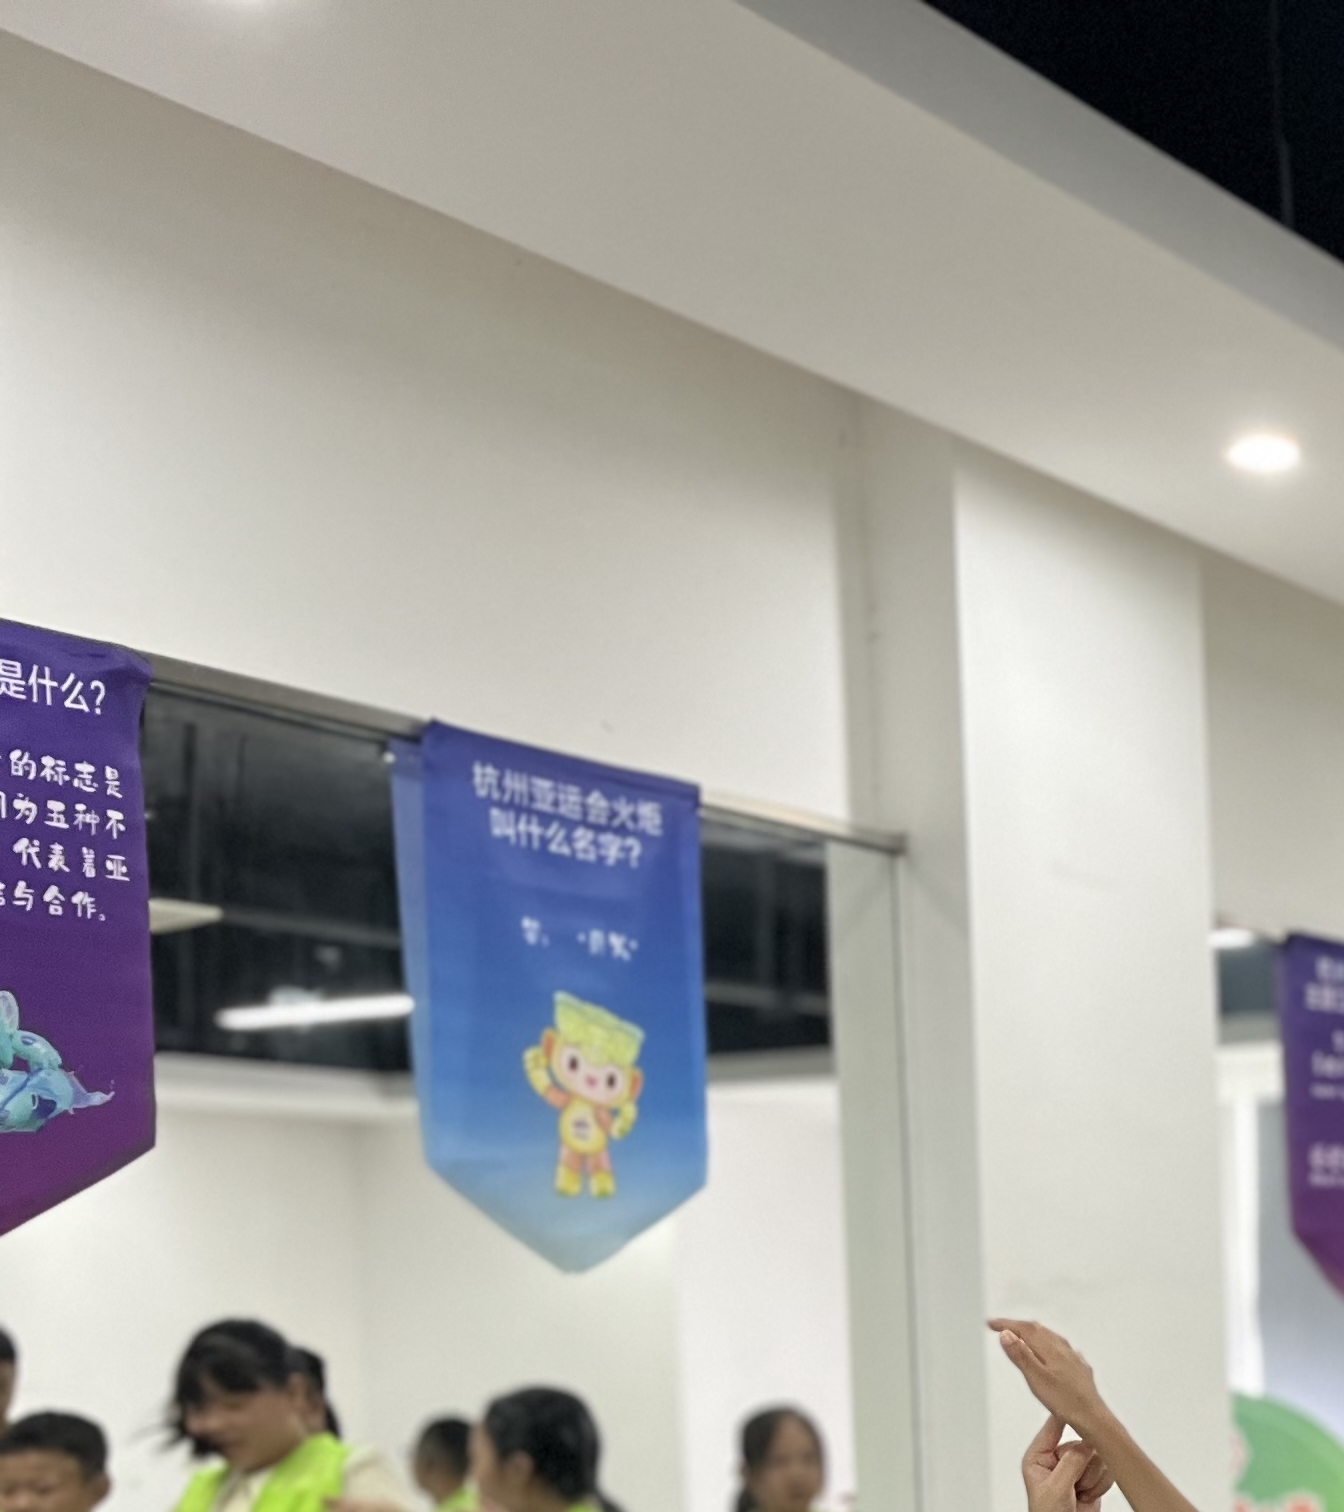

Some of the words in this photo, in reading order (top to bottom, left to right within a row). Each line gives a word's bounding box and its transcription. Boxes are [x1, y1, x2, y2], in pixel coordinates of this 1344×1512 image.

[0, 659, 106, 715] 是什么?
[9, 748, 123, 799] 的标志是
[13, 837, 130, 882] 代表着亚
